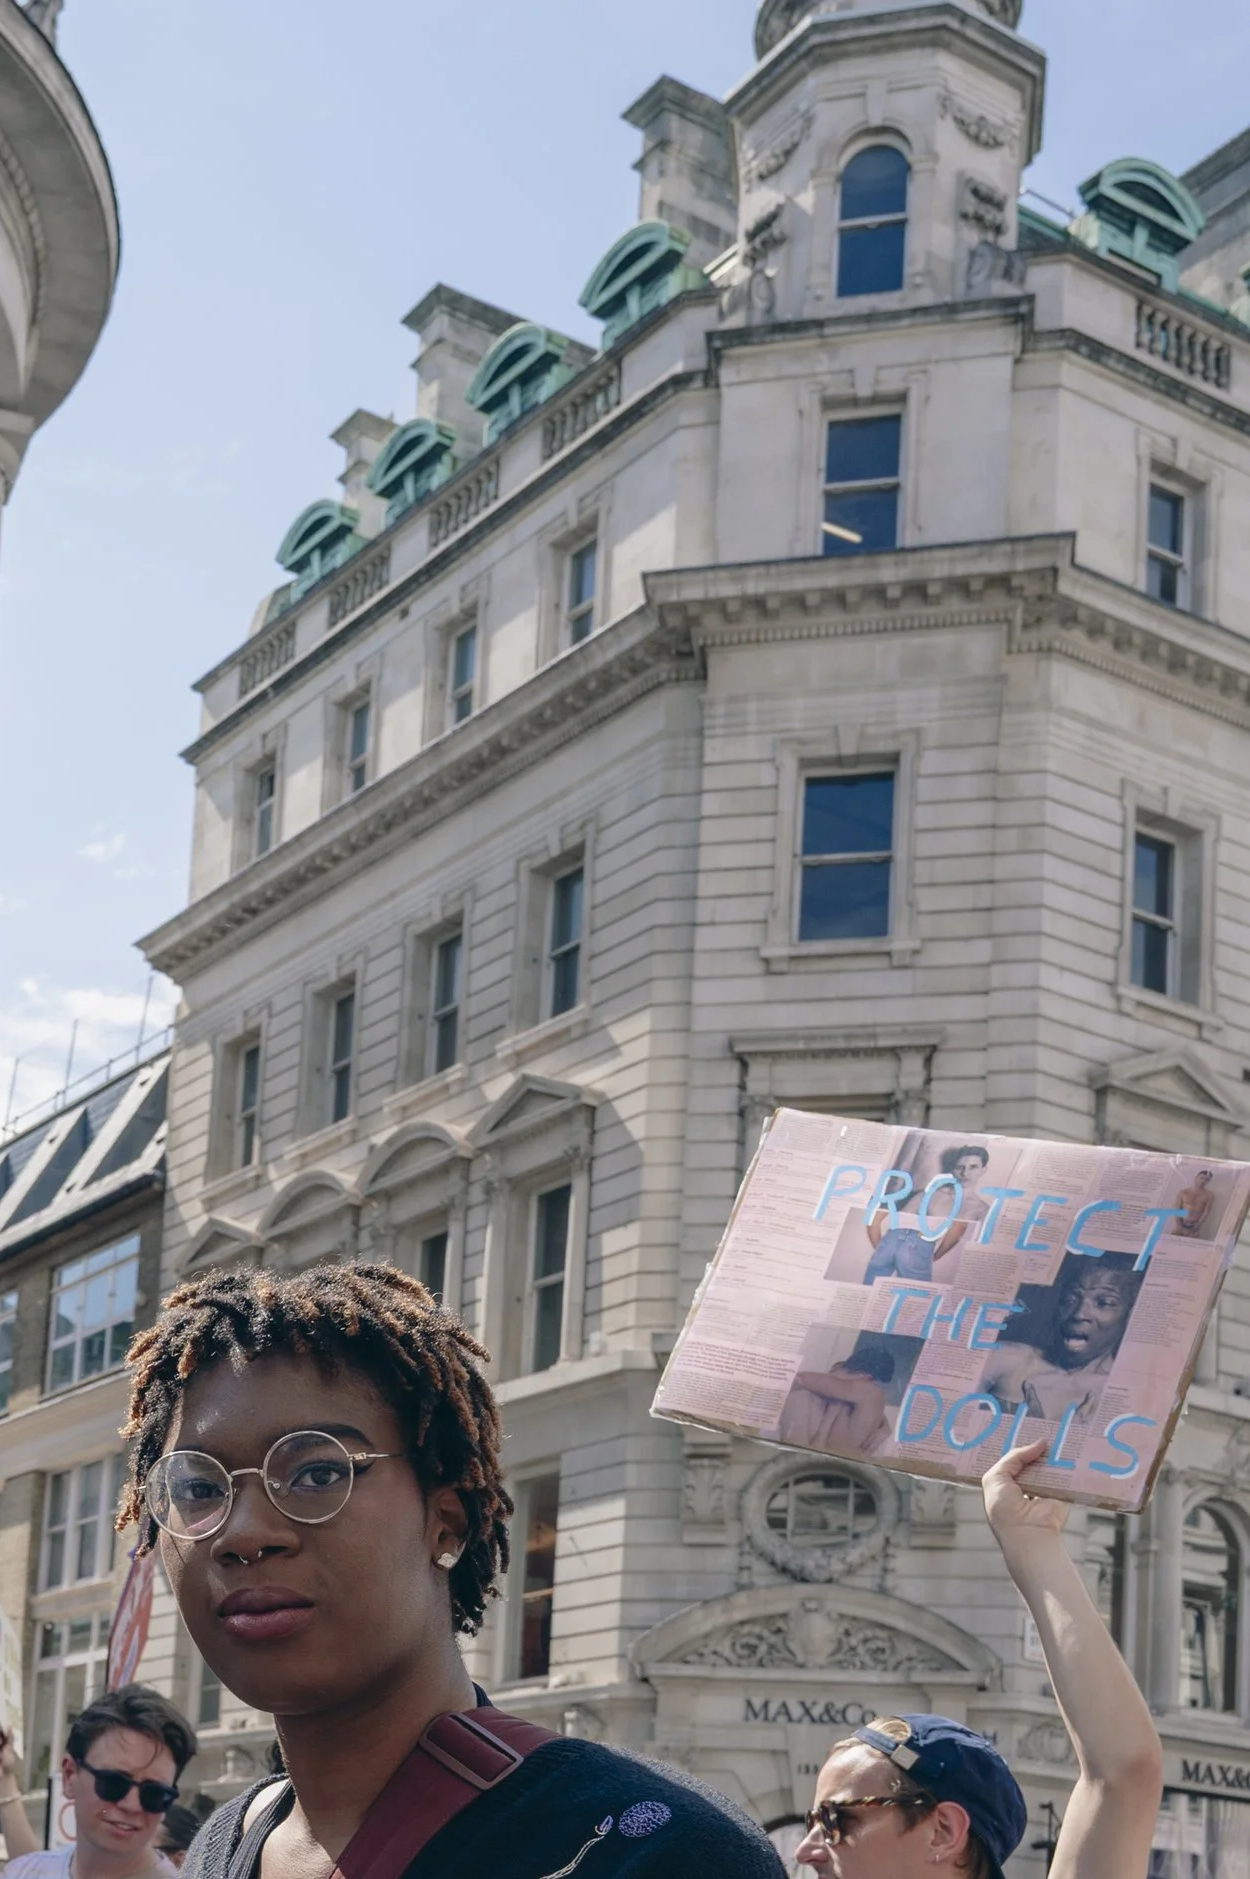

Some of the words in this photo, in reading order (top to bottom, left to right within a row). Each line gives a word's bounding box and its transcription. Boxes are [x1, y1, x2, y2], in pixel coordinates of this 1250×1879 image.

[812, 1165, 1189, 1272] PROTECT
[883, 1287, 1025, 1350] THE
[895, 1385, 1157, 1479] DOLLS
[1181, 1758, 1250, 1791] MAX&
